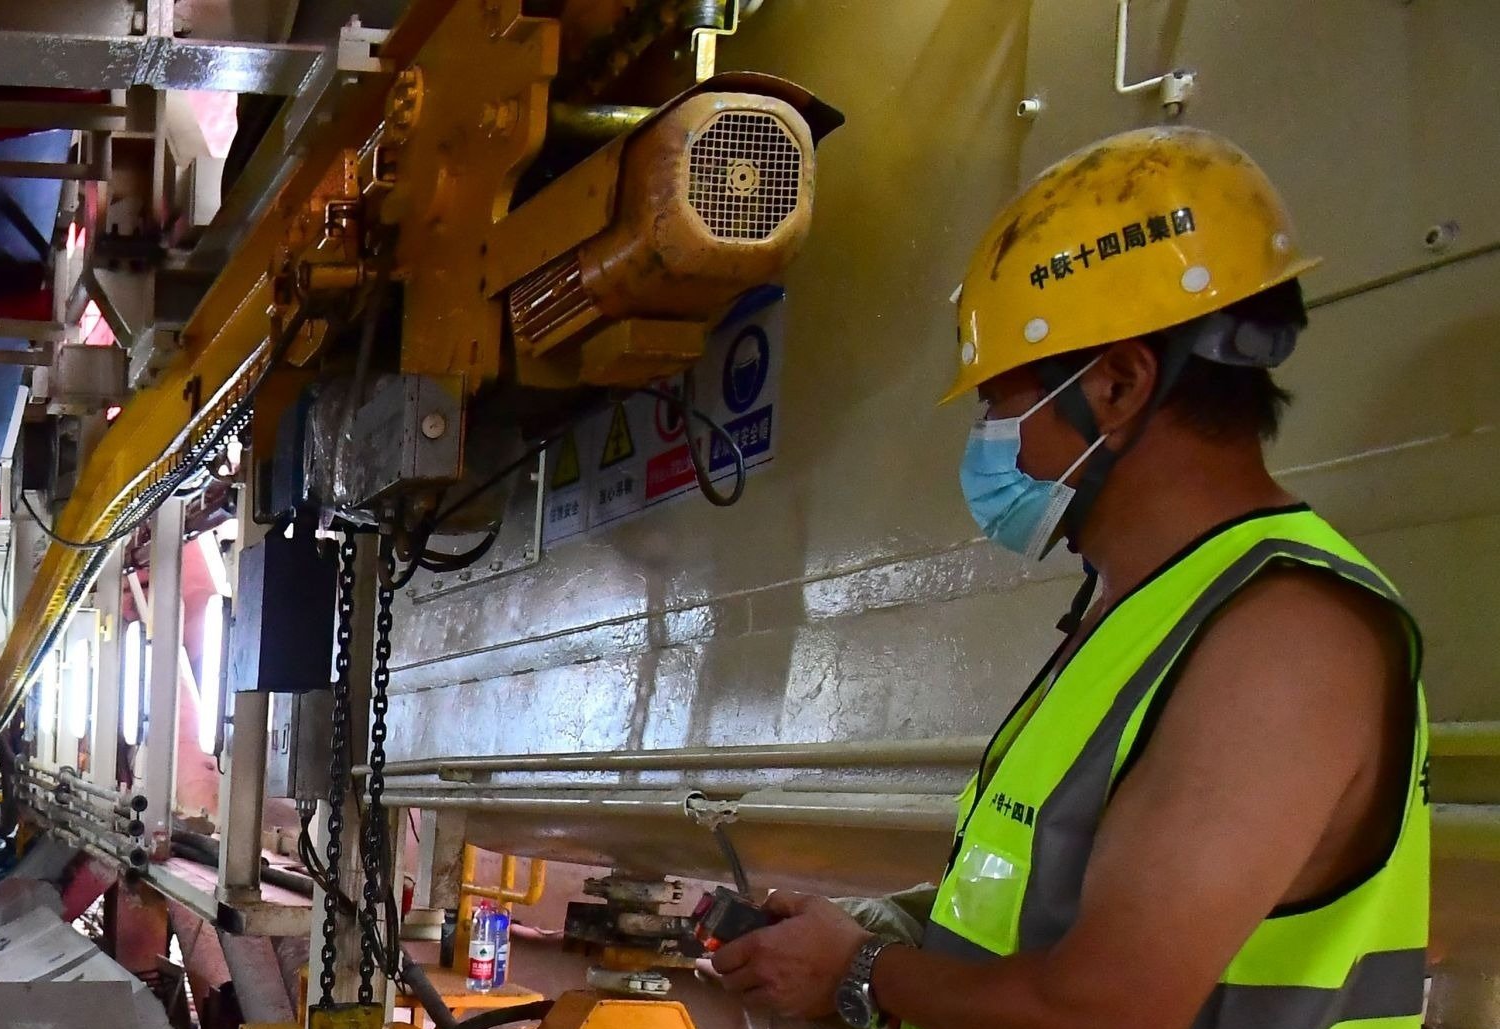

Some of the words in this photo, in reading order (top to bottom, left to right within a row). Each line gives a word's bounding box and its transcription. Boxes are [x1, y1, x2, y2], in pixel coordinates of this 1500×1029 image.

[1030, 207, 1196, 290] 中铁十四局集团
